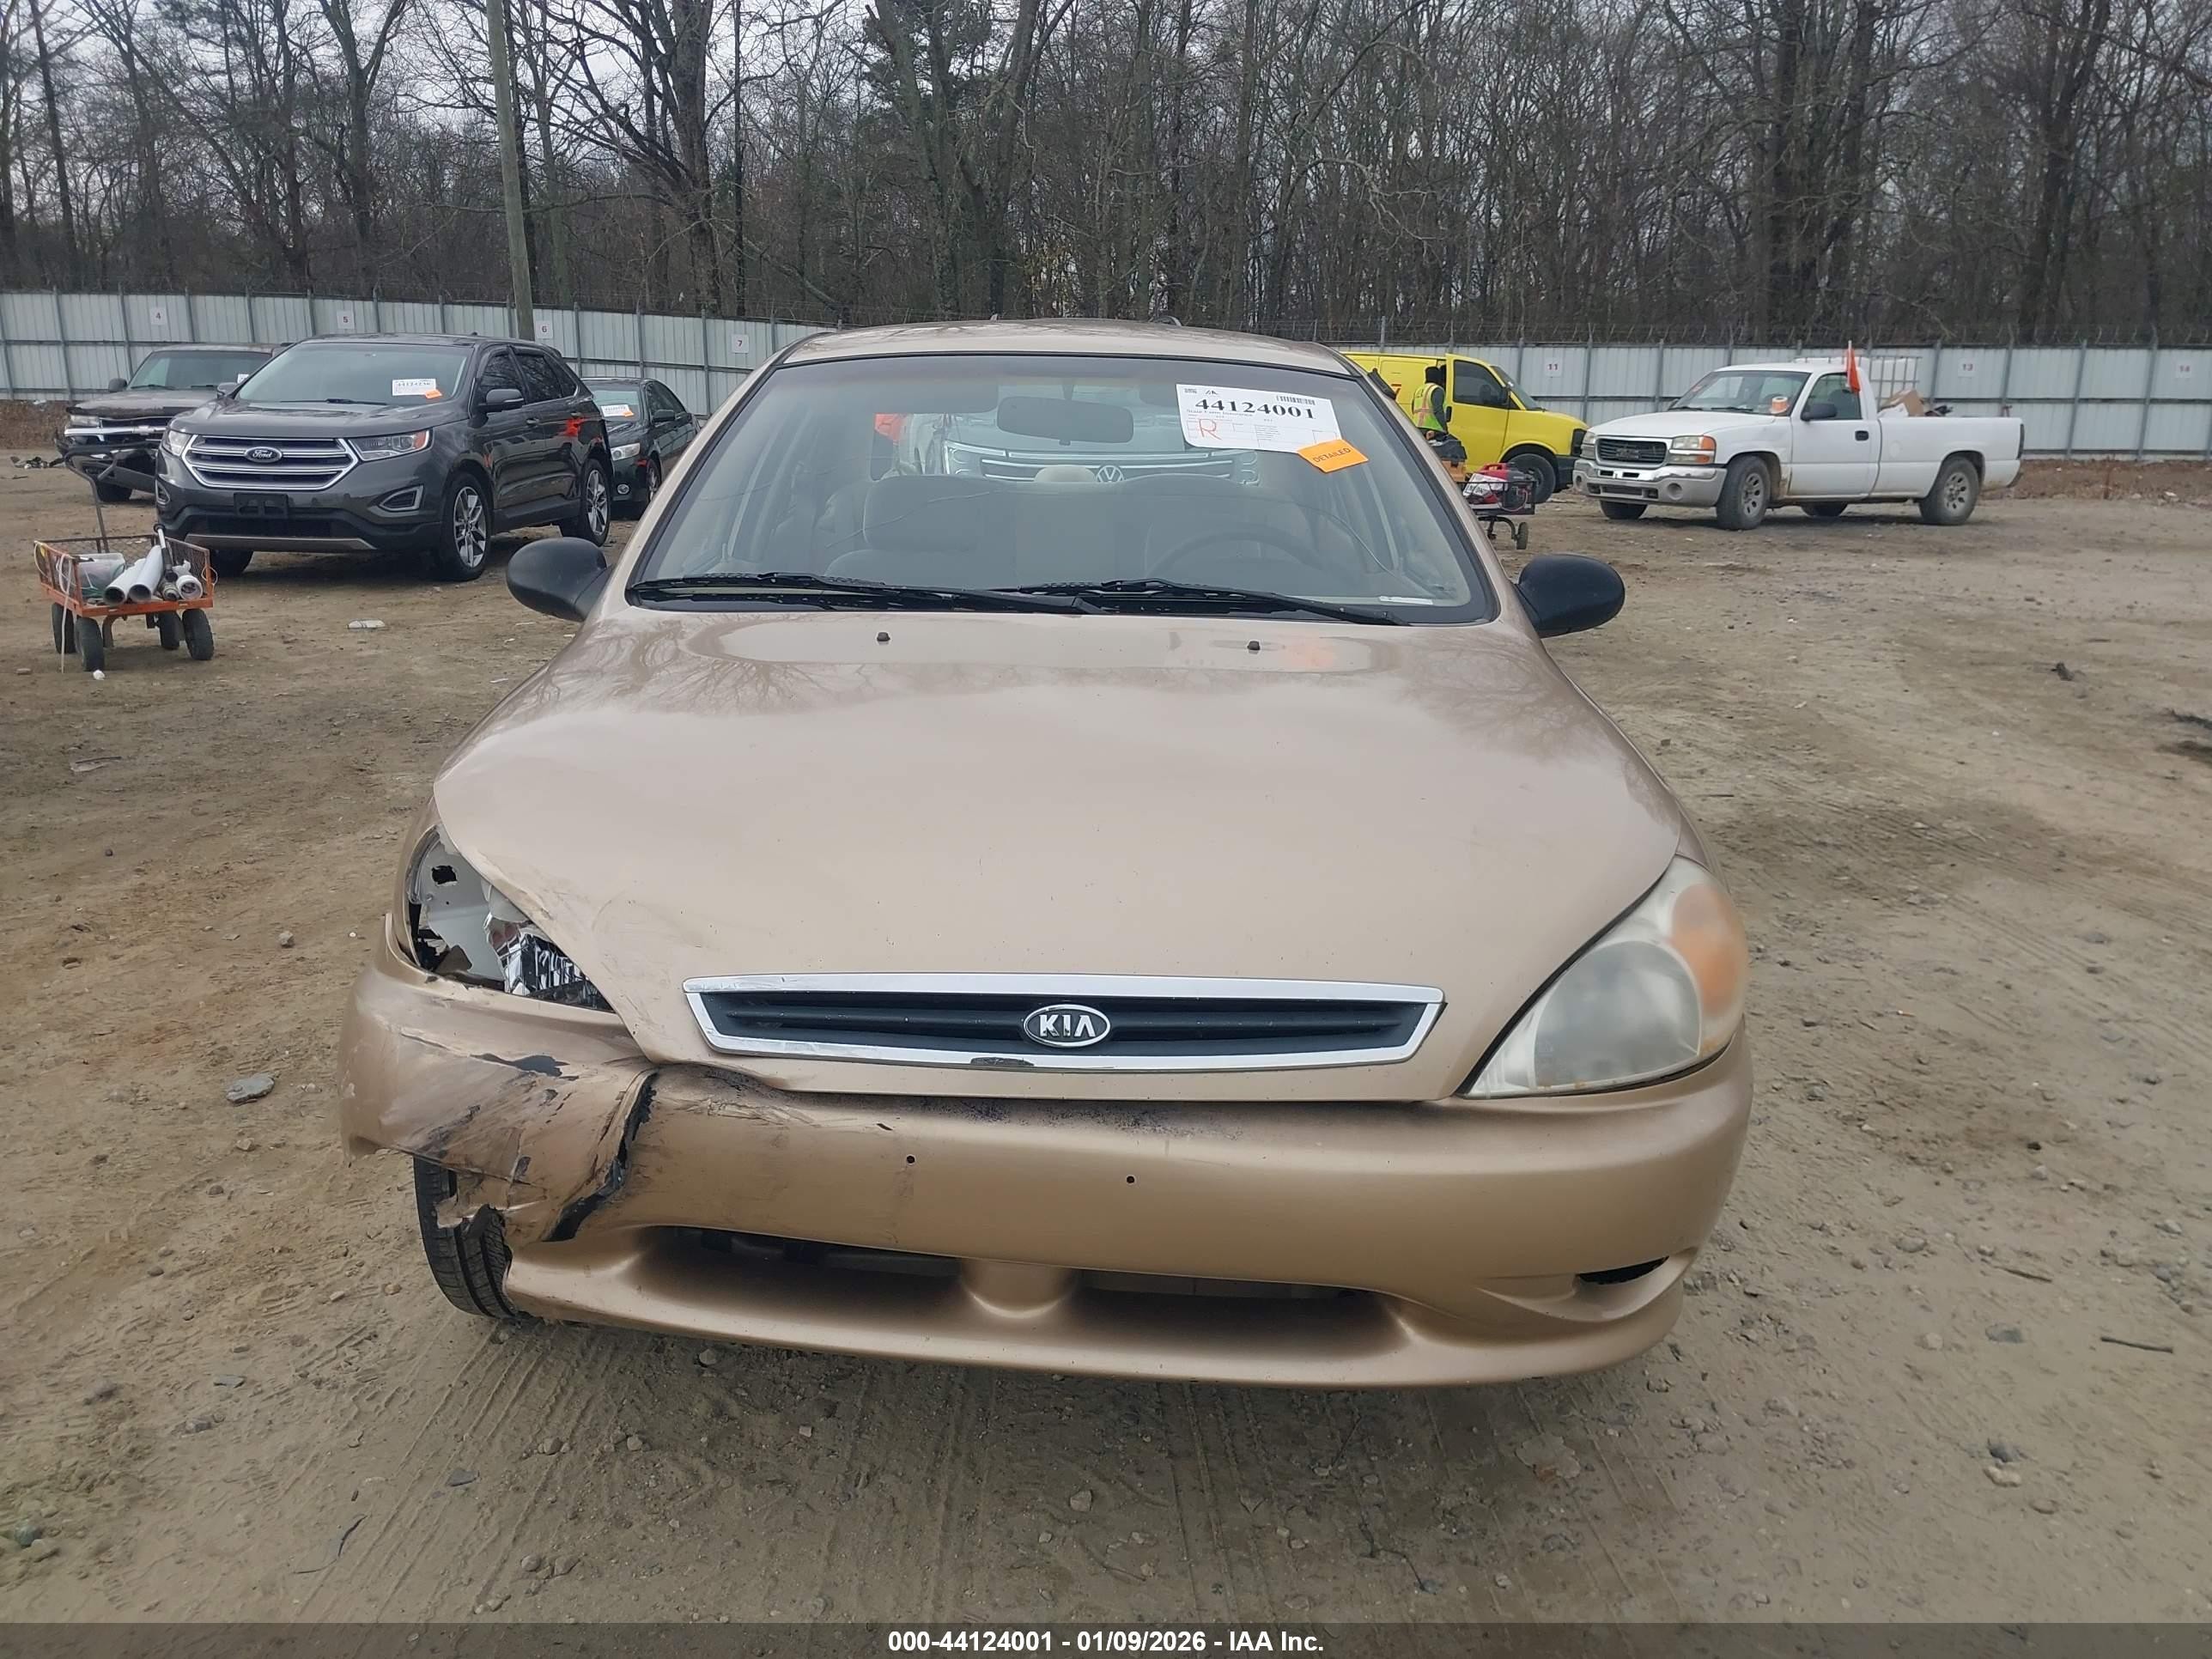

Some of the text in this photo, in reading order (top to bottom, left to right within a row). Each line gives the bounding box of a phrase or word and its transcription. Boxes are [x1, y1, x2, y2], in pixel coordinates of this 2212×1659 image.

[1195, 399, 1316, 419] 44124001
[1199, 418, 1222, 441] R
[252, 449, 273, 459] Ford
[1312, 447, 1351, 463] DETAILED
[1039, 1014, 1097, 1037] KIA
